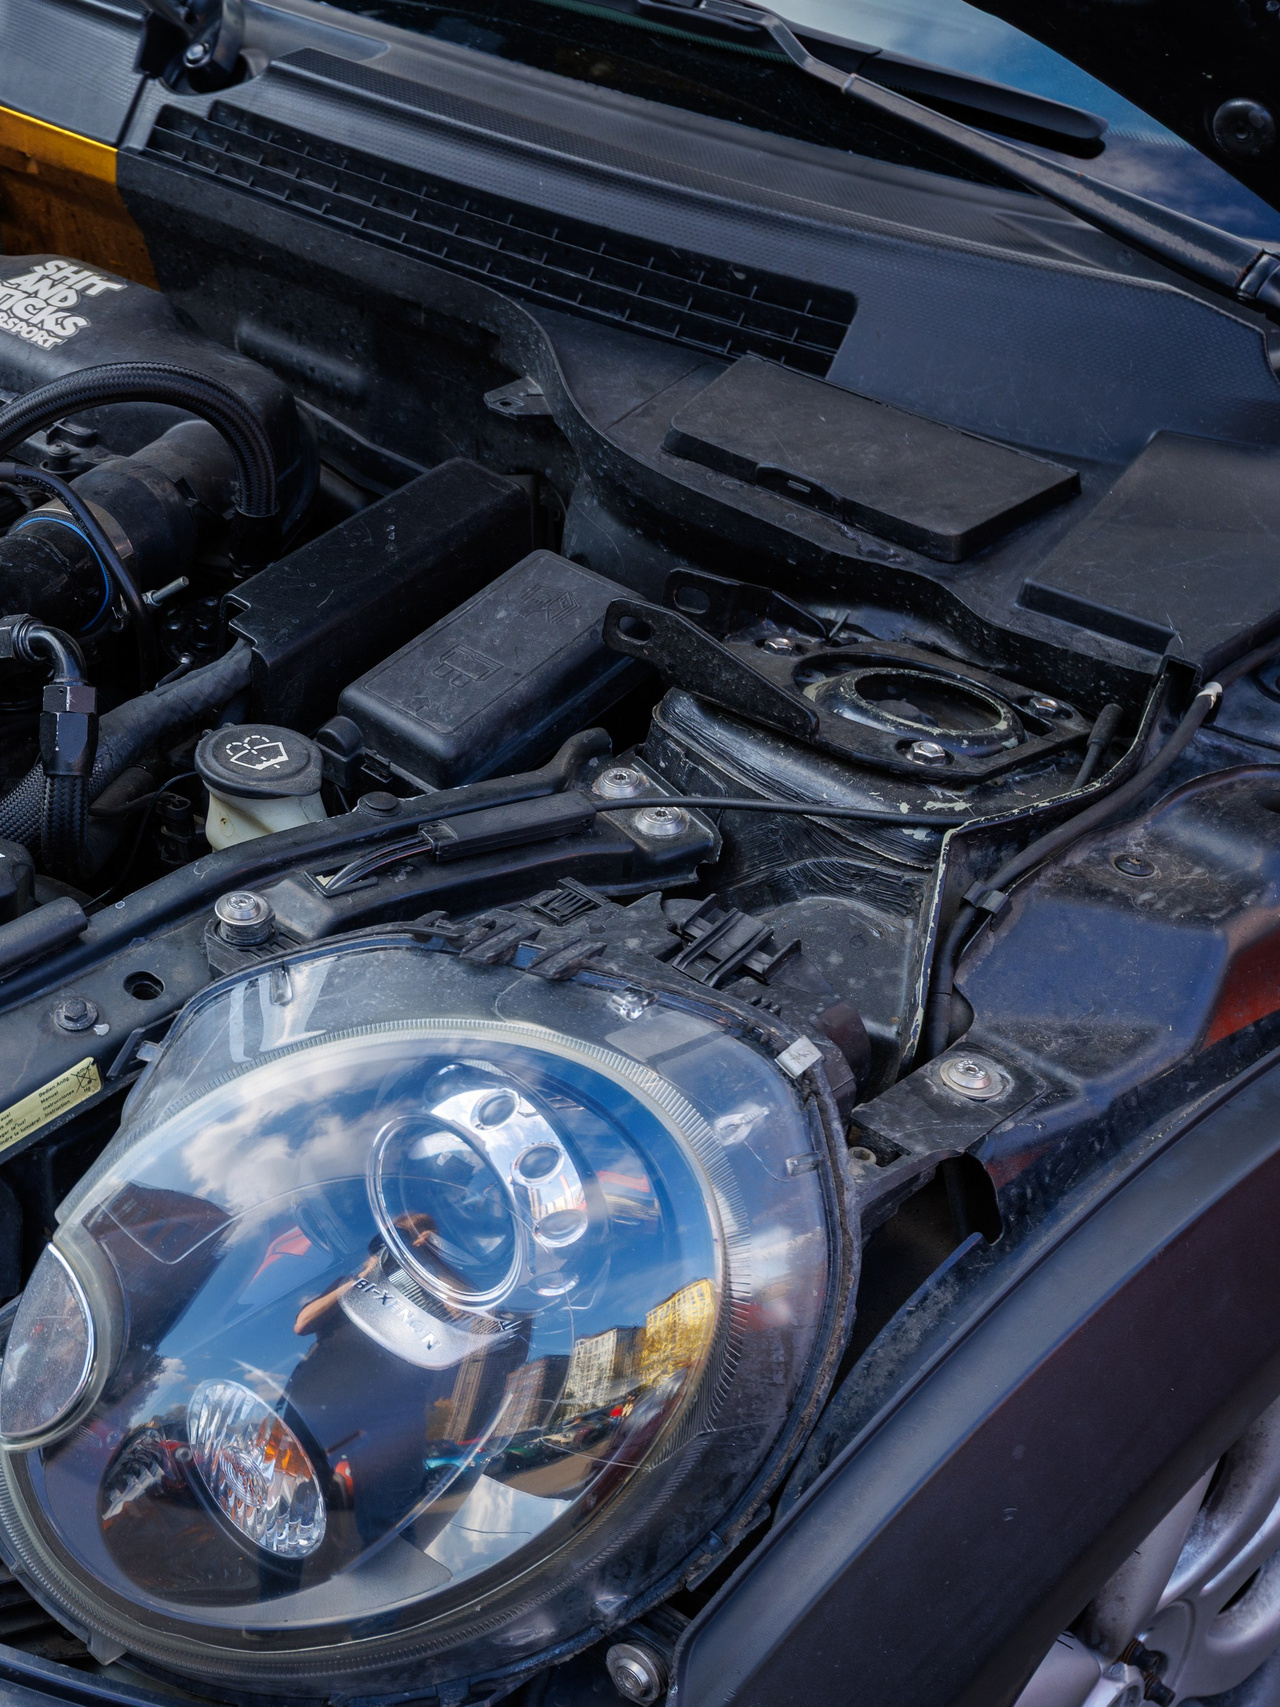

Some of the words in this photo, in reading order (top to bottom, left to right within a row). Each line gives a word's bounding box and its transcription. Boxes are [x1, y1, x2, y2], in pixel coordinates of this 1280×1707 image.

[7, 272, 78, 308] AND
[33, 260, 124, 296] SHIT
[40, 1091, 59, 1104] Manual
[351, 1277, 442, 1351] BI-XENON
